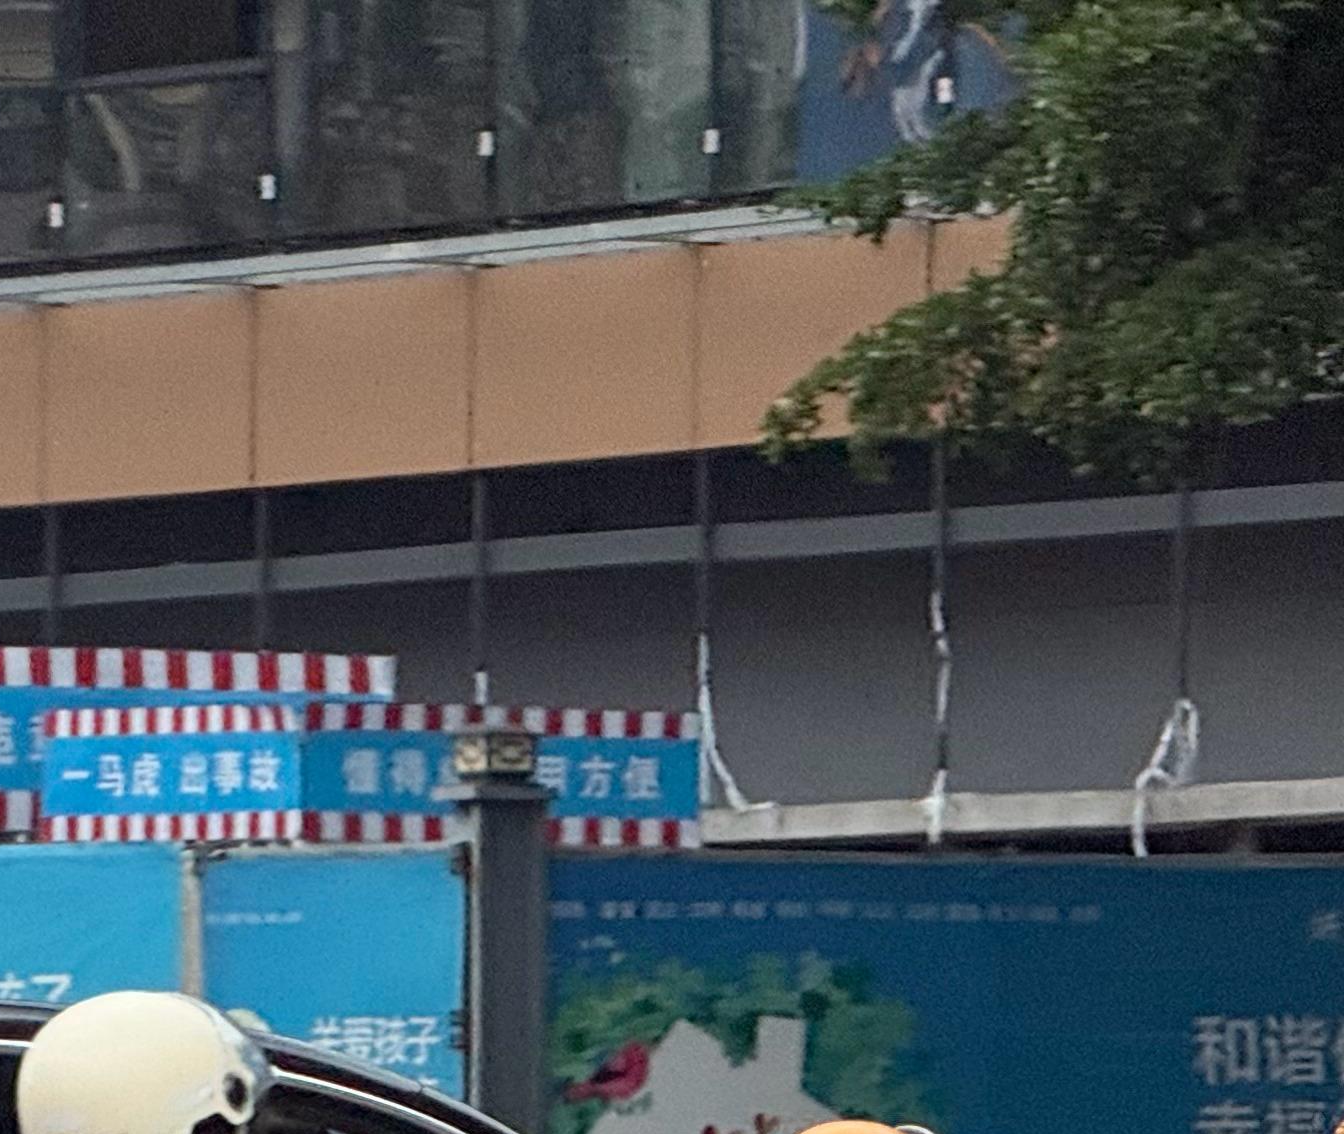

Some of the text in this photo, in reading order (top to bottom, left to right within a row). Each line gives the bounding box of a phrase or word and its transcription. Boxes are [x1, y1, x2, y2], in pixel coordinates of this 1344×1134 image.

[62, 750, 282, 797] 一马虎 出事故
[1192, 1014, 1344, 1086] 和谐
